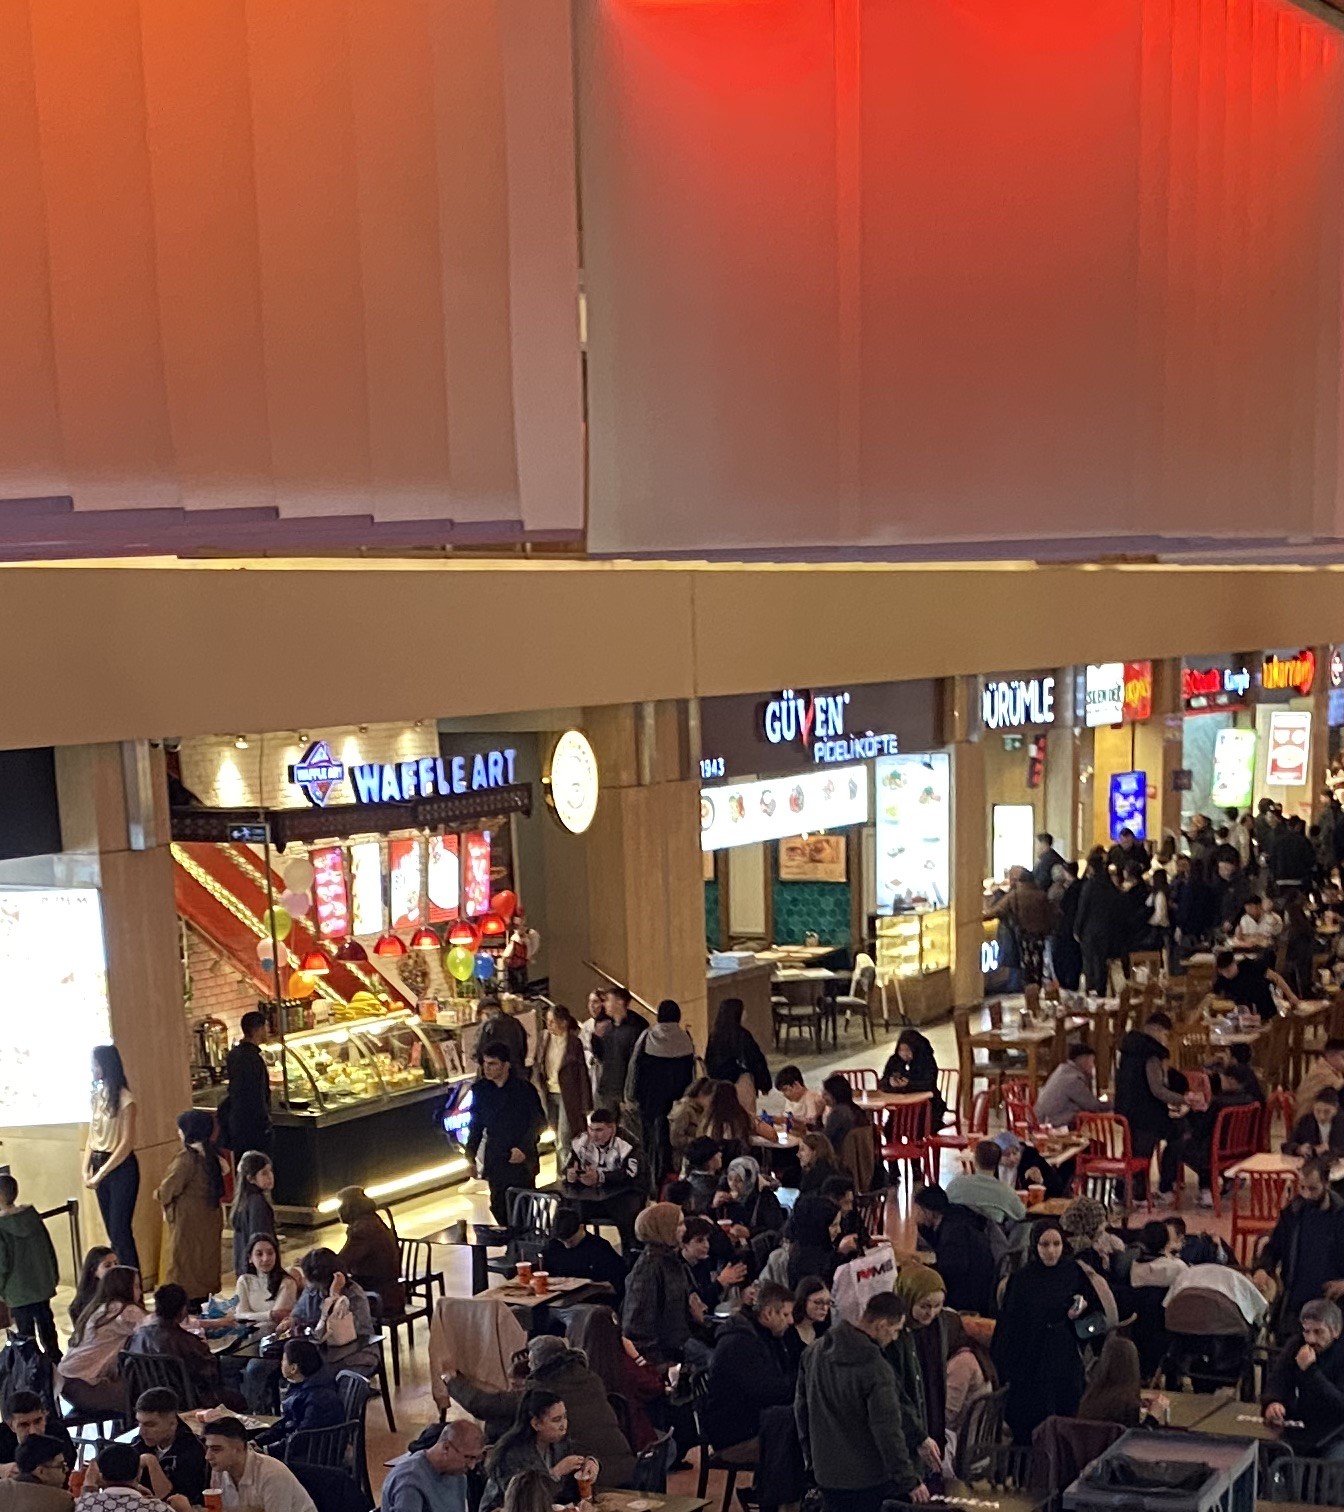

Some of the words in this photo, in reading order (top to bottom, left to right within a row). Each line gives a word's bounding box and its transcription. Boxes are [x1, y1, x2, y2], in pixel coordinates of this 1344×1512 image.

[765, 689, 845, 747] GÜVEN
[353, 757, 468, 804] WAFFLE
[472, 749, 517, 791] ART
